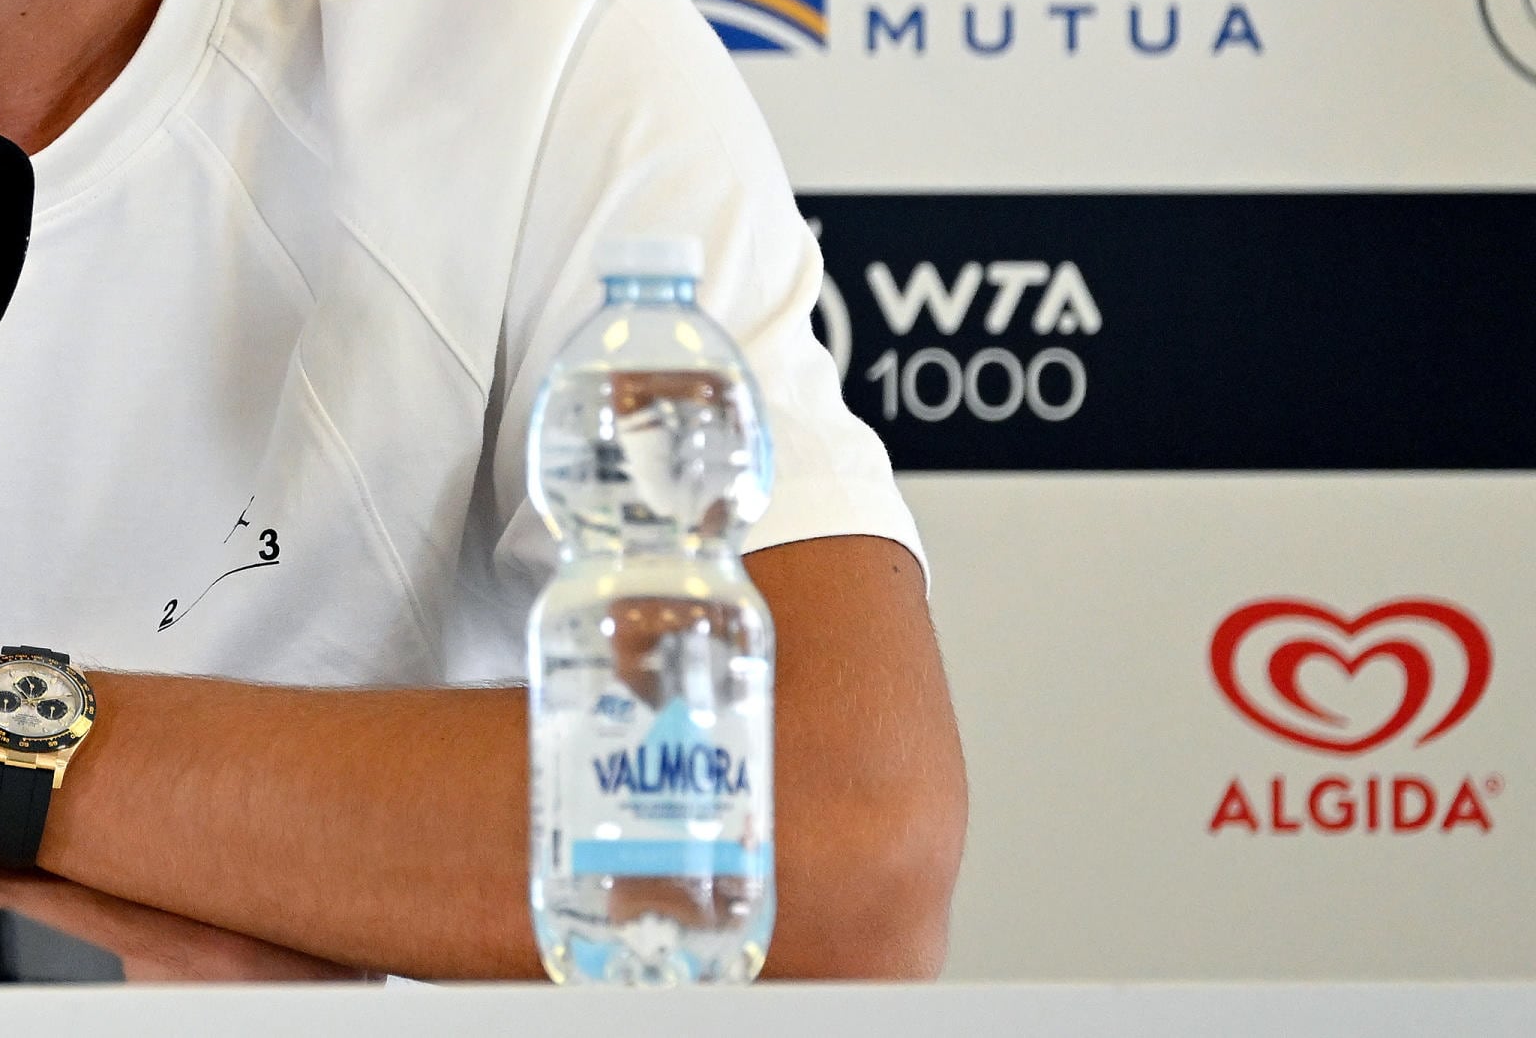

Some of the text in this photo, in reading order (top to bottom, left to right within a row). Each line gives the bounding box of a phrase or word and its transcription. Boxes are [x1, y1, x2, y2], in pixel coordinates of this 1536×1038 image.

[866, 5, 1263, 55] MUTUA
[865, 259, 1104, 335] WTA
[865, 346, 1088, 422] 1000
[258, 528, 280, 561] 3
[158, 598, 178, 627] 2
[592, 741, 751, 795] VALMORA
[1208, 773, 1493, 834] ALGIDA
